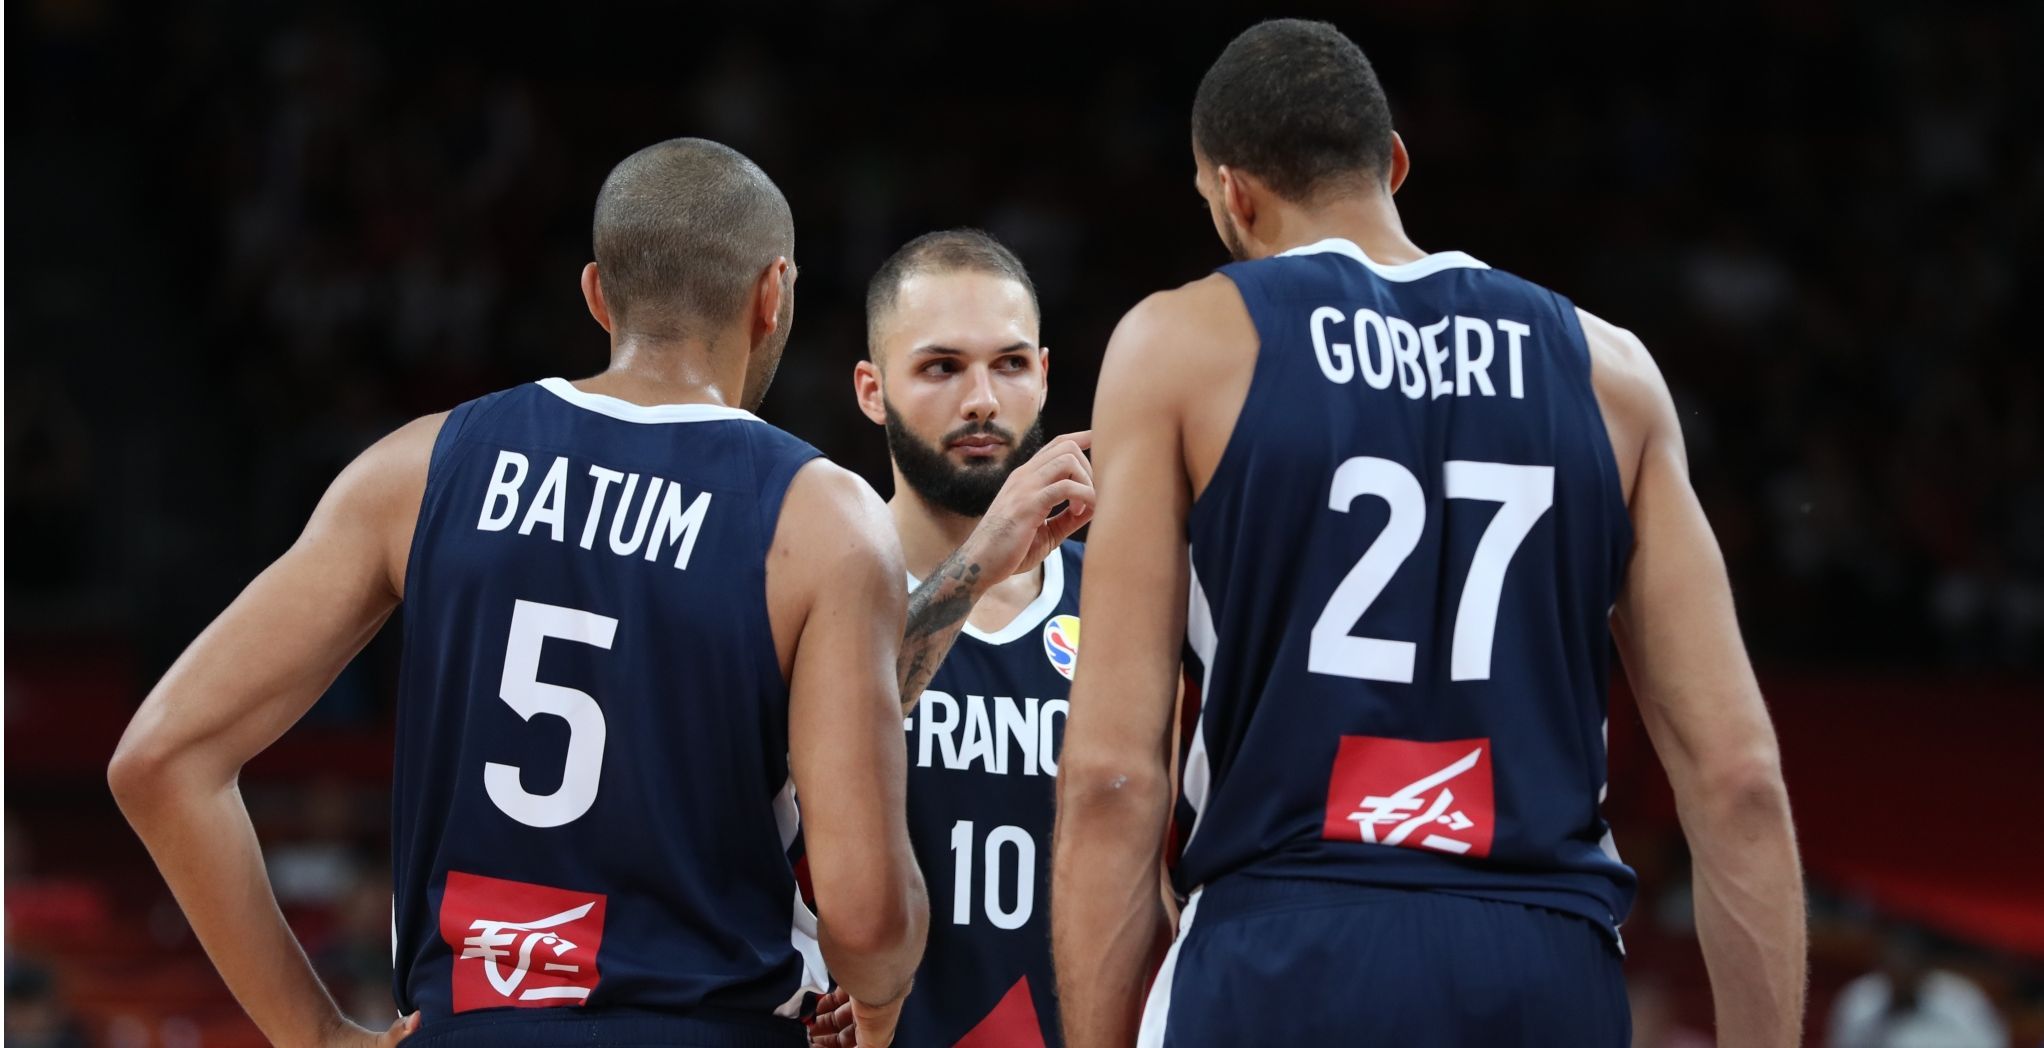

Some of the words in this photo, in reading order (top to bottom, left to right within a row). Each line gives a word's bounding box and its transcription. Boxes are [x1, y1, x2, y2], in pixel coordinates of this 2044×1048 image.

[1309, 306, 1531, 401] GOBERT
[476, 449, 713, 571] BATUM
[1307, 455, 1555, 684] 27
[483, 598, 619, 828] 5
[904, 689, 1071, 777] RANC
[950, 819, 1037, 931] 10
